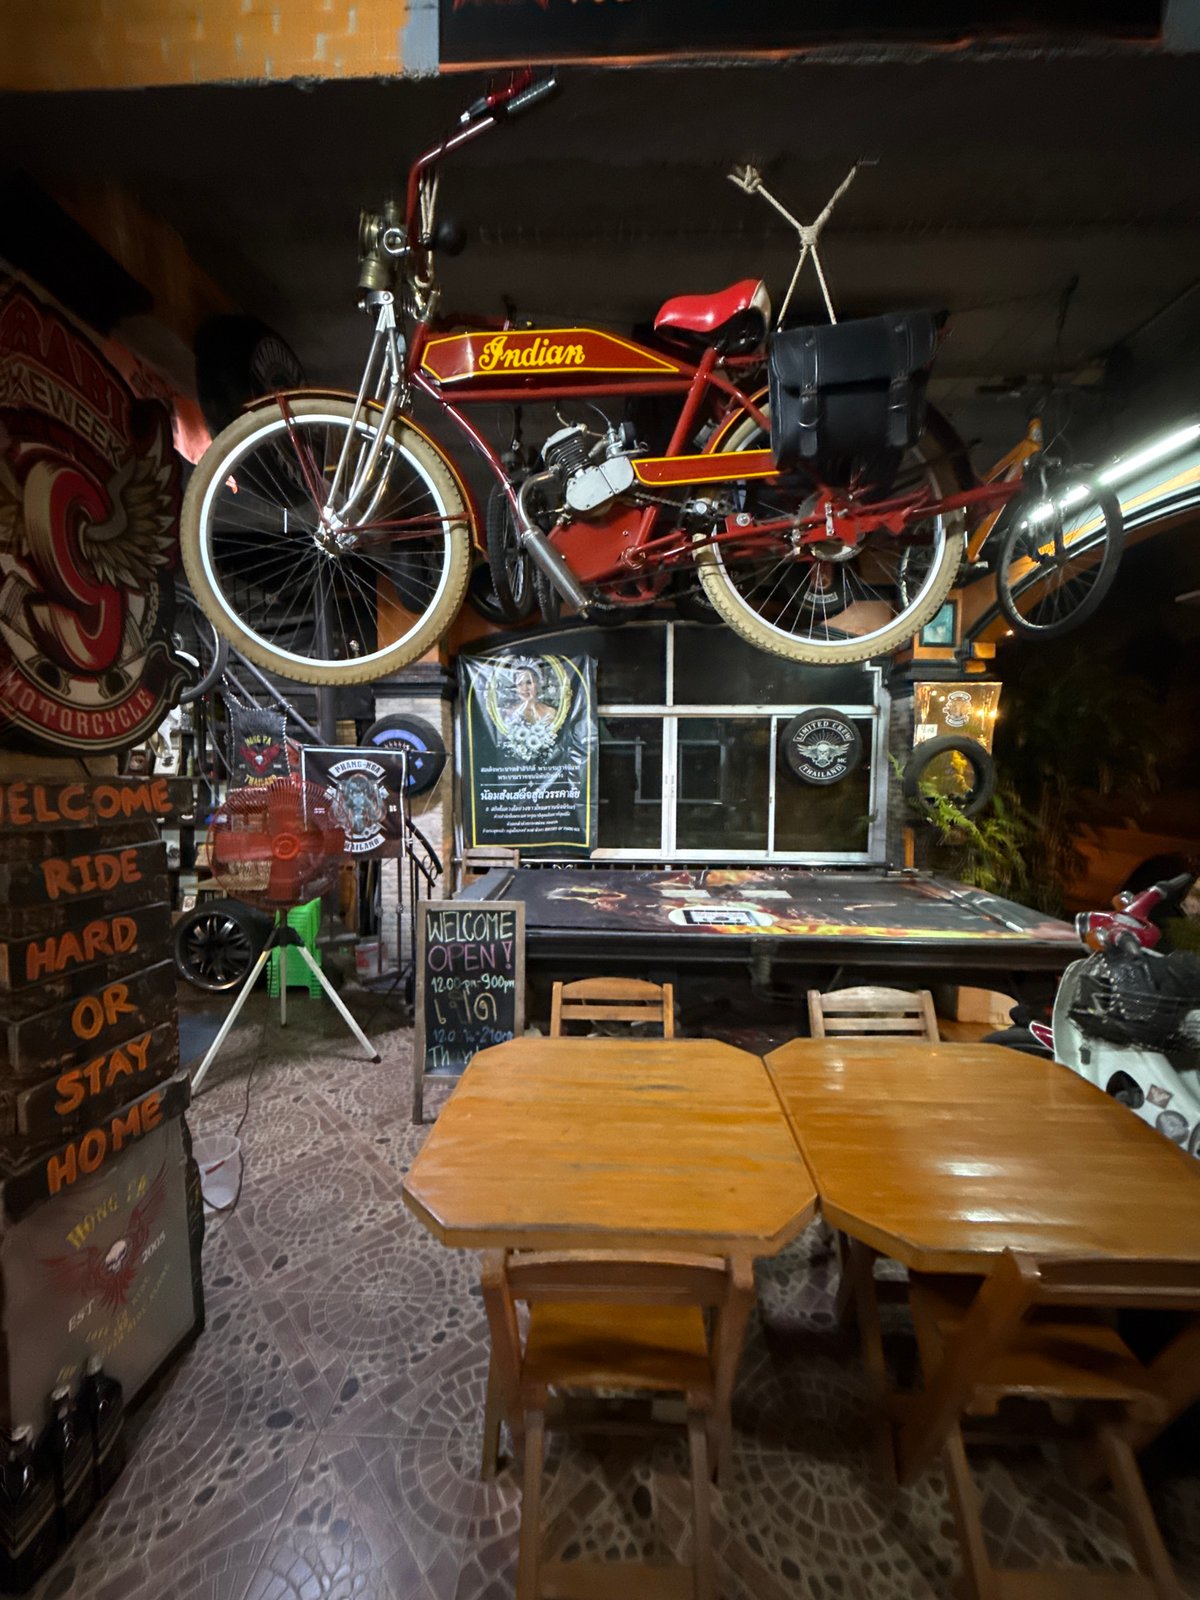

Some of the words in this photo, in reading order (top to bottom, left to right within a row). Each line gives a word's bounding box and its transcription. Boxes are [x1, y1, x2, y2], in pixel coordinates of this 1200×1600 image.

[479, 336, 586, 370] Indian
[6, 677, 152, 736] MOTORCYCLE
[796, 721, 829, 741] LIMITED
[832, 723, 852, 740] CREW
[802, 765, 843, 778] THAILAND
[345, 837, 380, 850] HAILAND
[40, 848, 144, 900] RIDE
[26, 916, 138, 981] HARD
[427, 910, 513, 943] WELCOME
[71, 983, 139, 1040] OR
[54, 1033, 152, 1115] STAY
[47, 1092, 163, 1194] HOME
